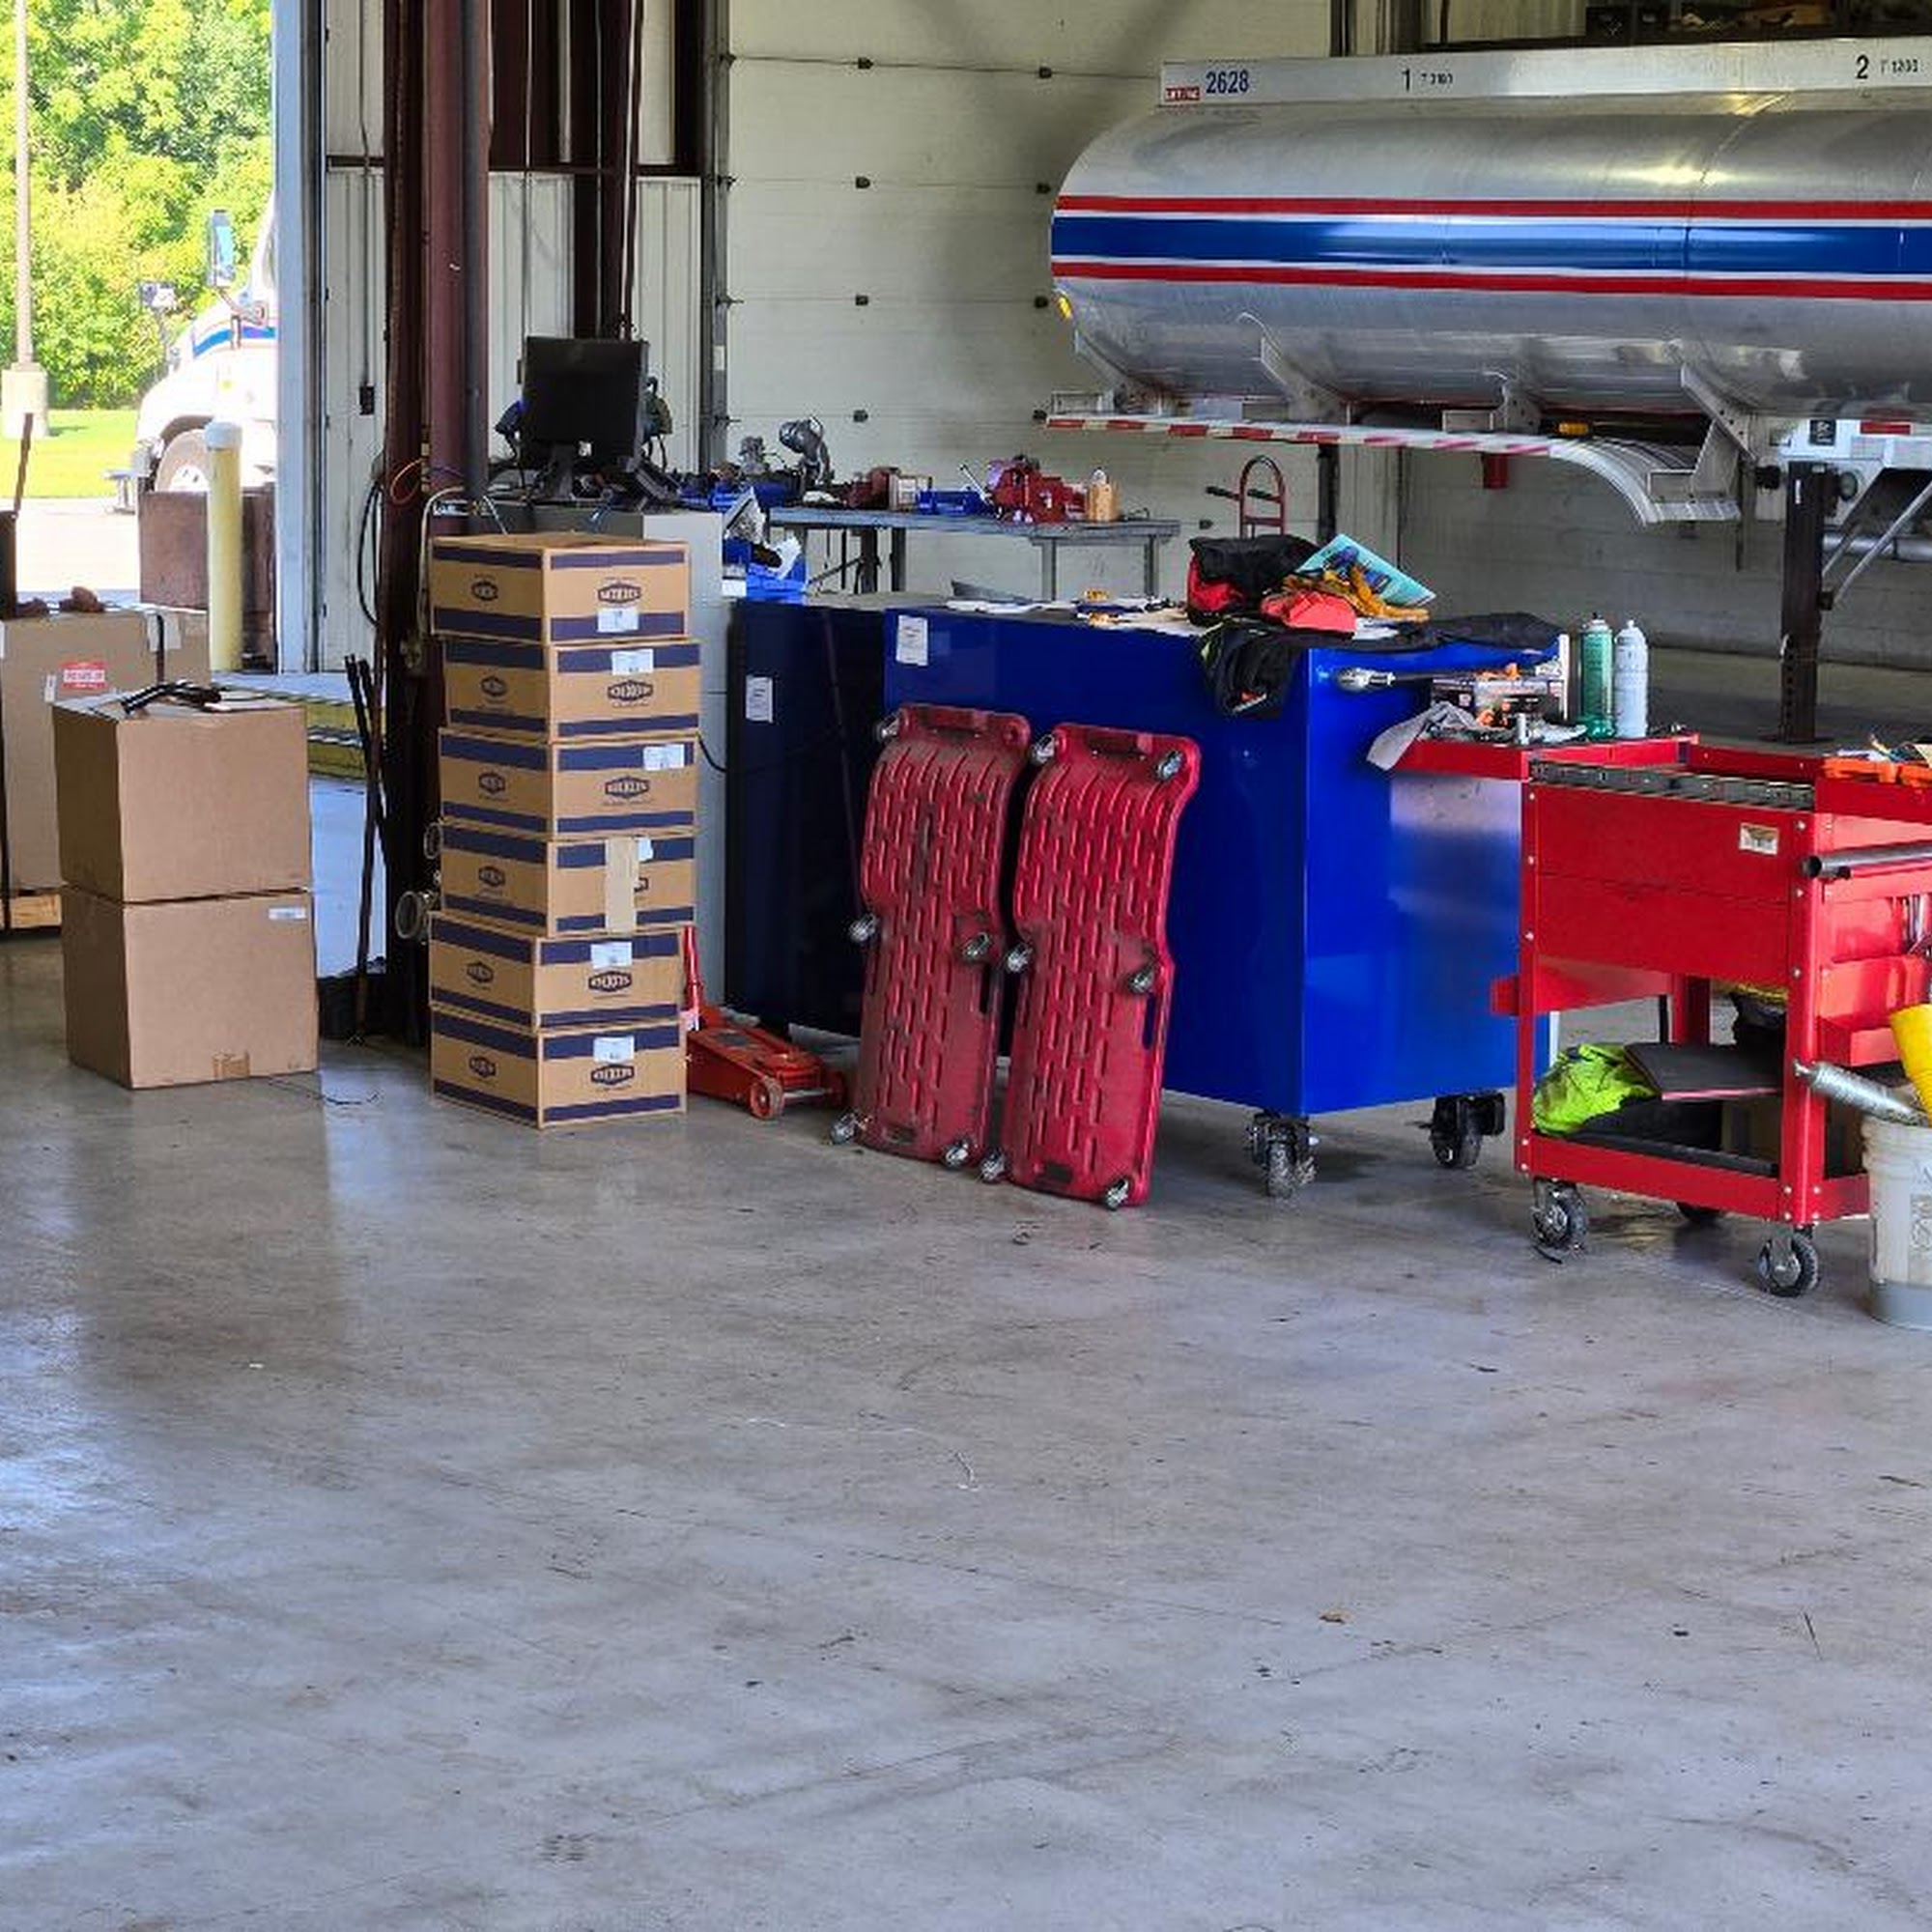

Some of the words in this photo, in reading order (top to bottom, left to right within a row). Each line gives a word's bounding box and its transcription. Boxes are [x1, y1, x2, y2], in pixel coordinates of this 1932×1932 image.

[1855, 54, 1869, 79] 2
[1206, 70, 1249, 94] 2628
[1402, 68, 1410, 92] 1
